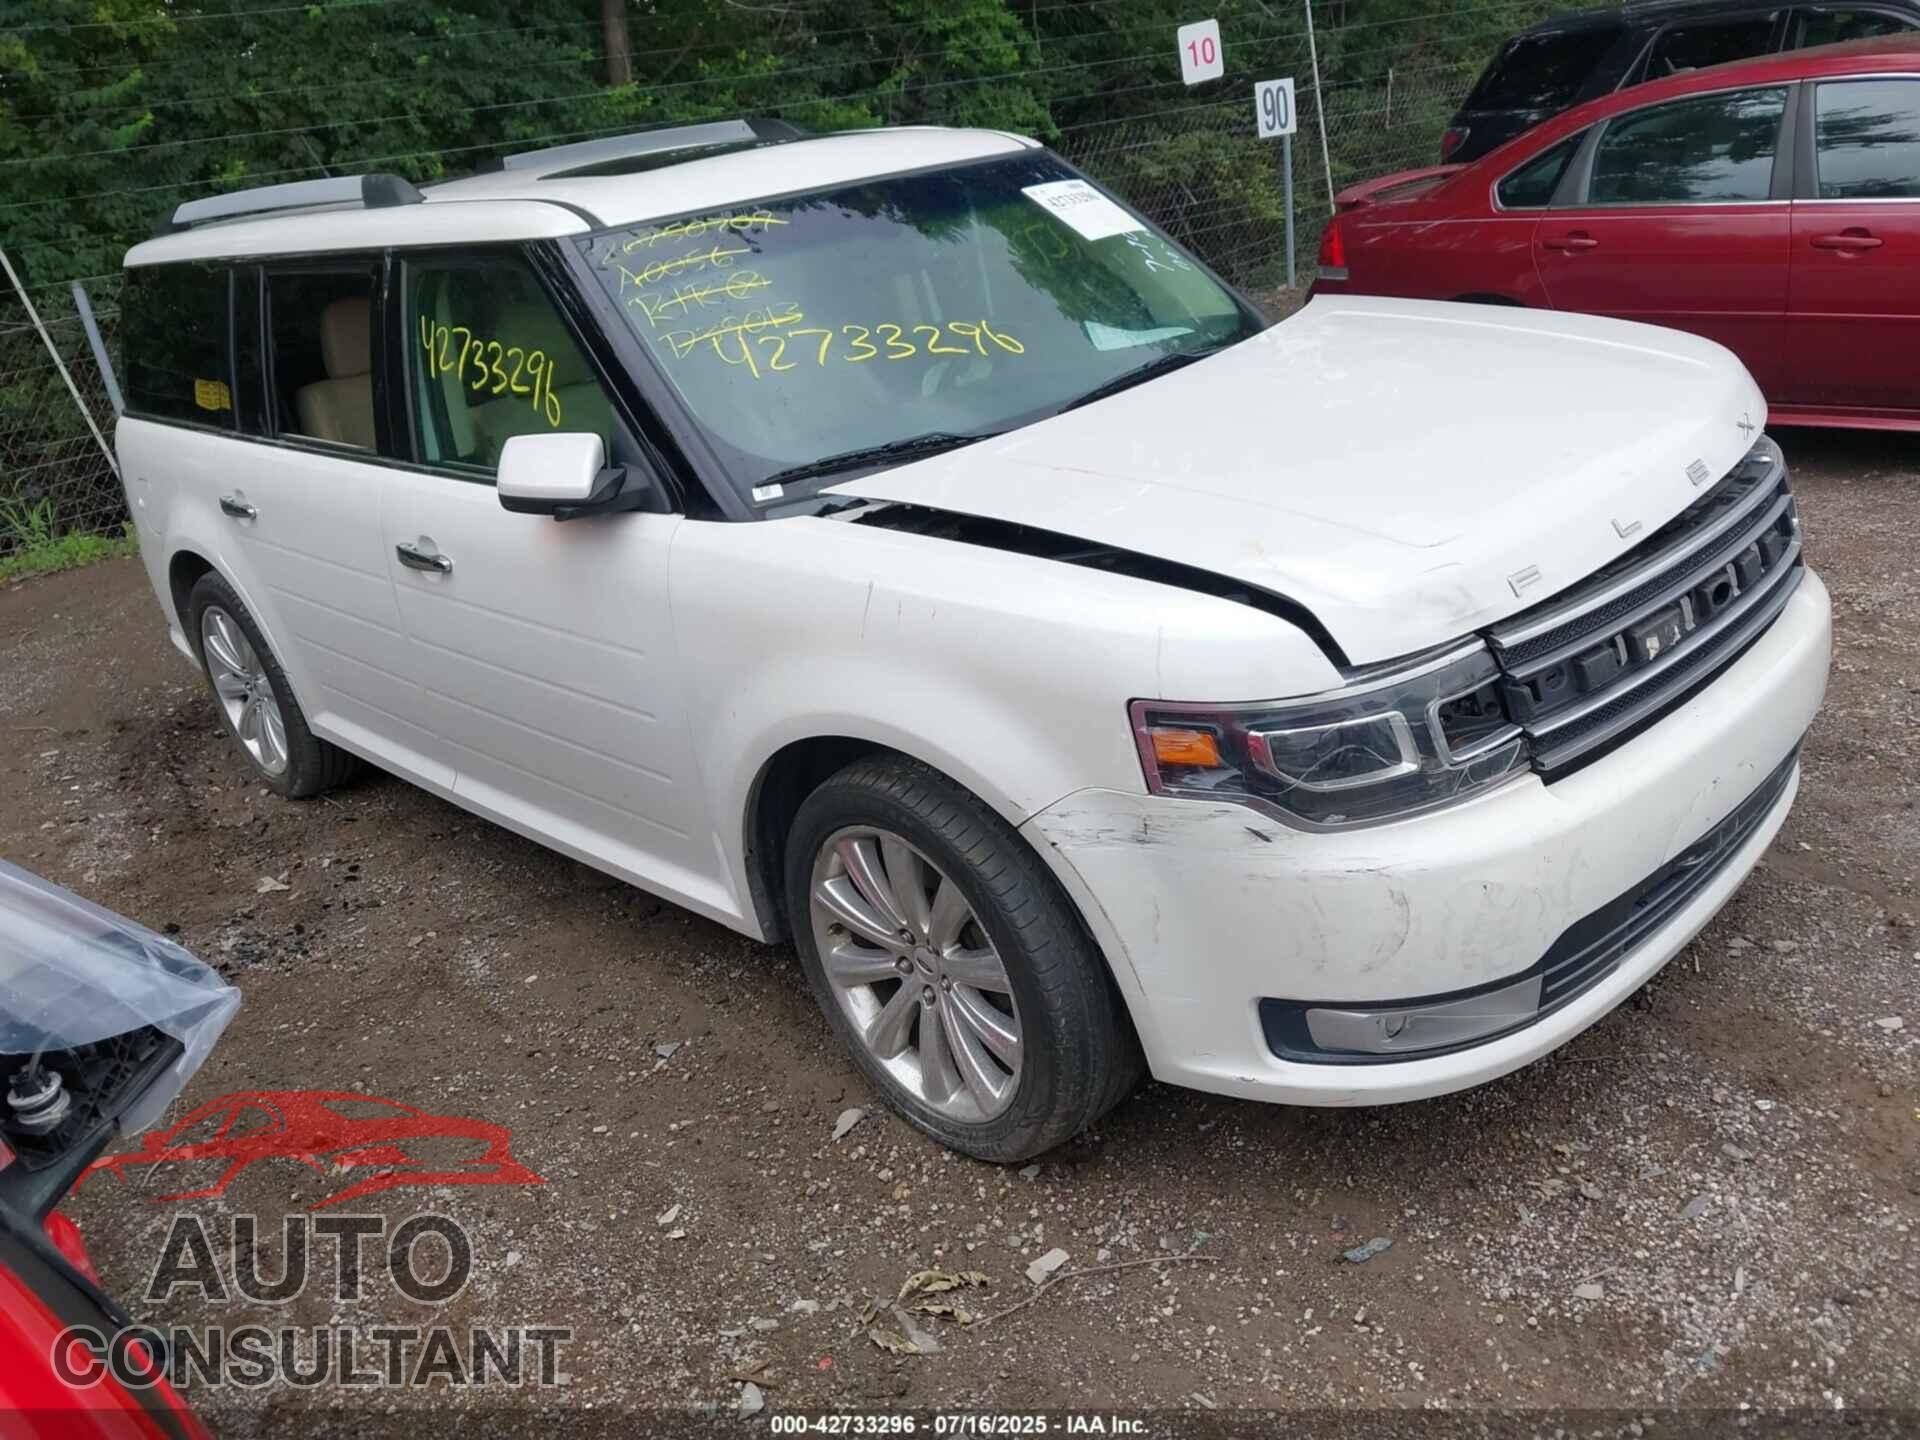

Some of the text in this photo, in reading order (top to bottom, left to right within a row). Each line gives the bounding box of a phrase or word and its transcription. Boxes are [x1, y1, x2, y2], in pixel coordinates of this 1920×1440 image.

[1187, 37, 1216, 67] 10
[1262, 85, 1290, 132] 90
[420, 315, 562, 428] 42733296
[711, 319, 1025, 379] 42733296
